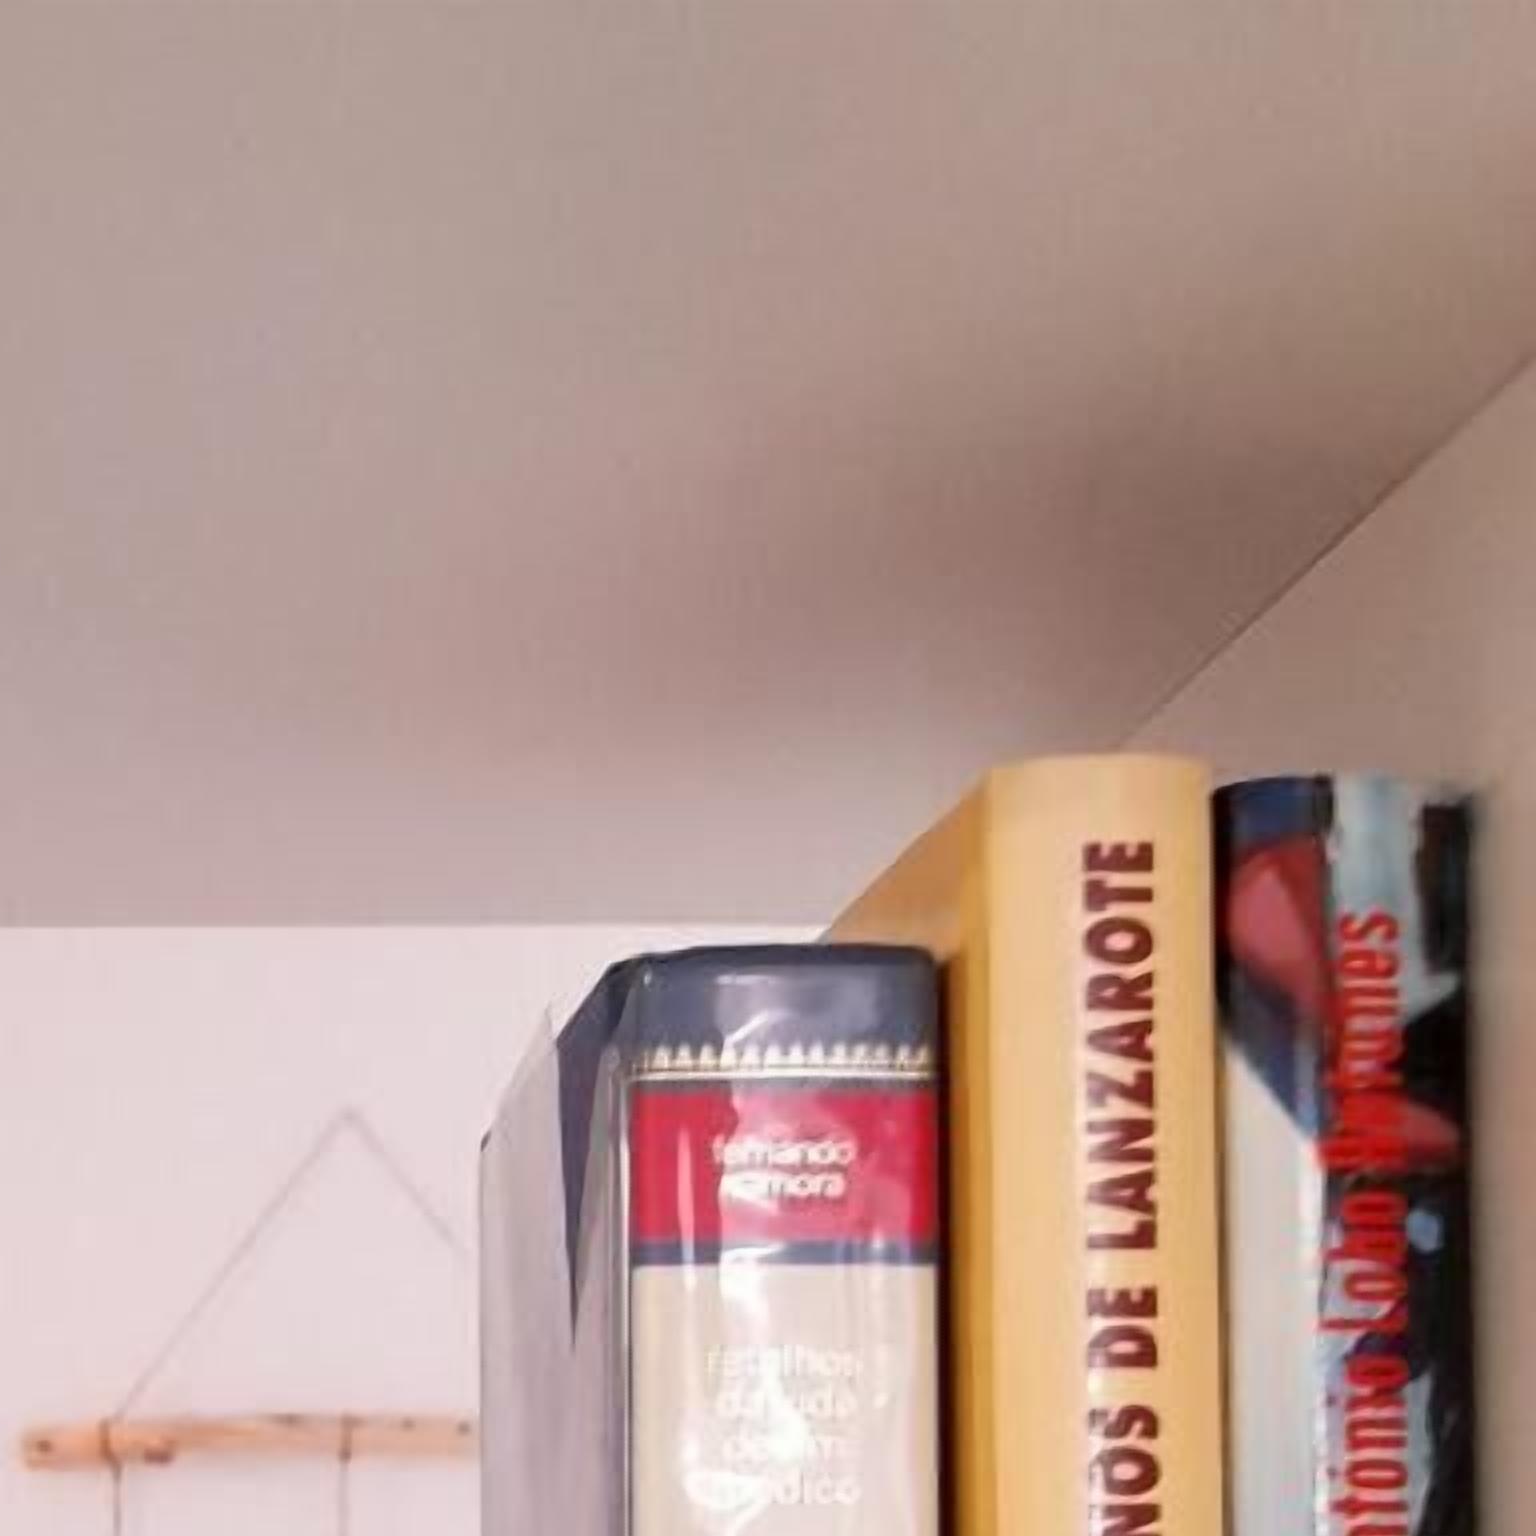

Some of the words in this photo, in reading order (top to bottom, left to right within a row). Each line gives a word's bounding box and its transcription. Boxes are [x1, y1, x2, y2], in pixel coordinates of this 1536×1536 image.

[1082, 841, 1158, 1250] LANZAROTE
[1087, 1286, 1159, 1369] DE
[1318, 1190, 1408, 1332] Lobo
